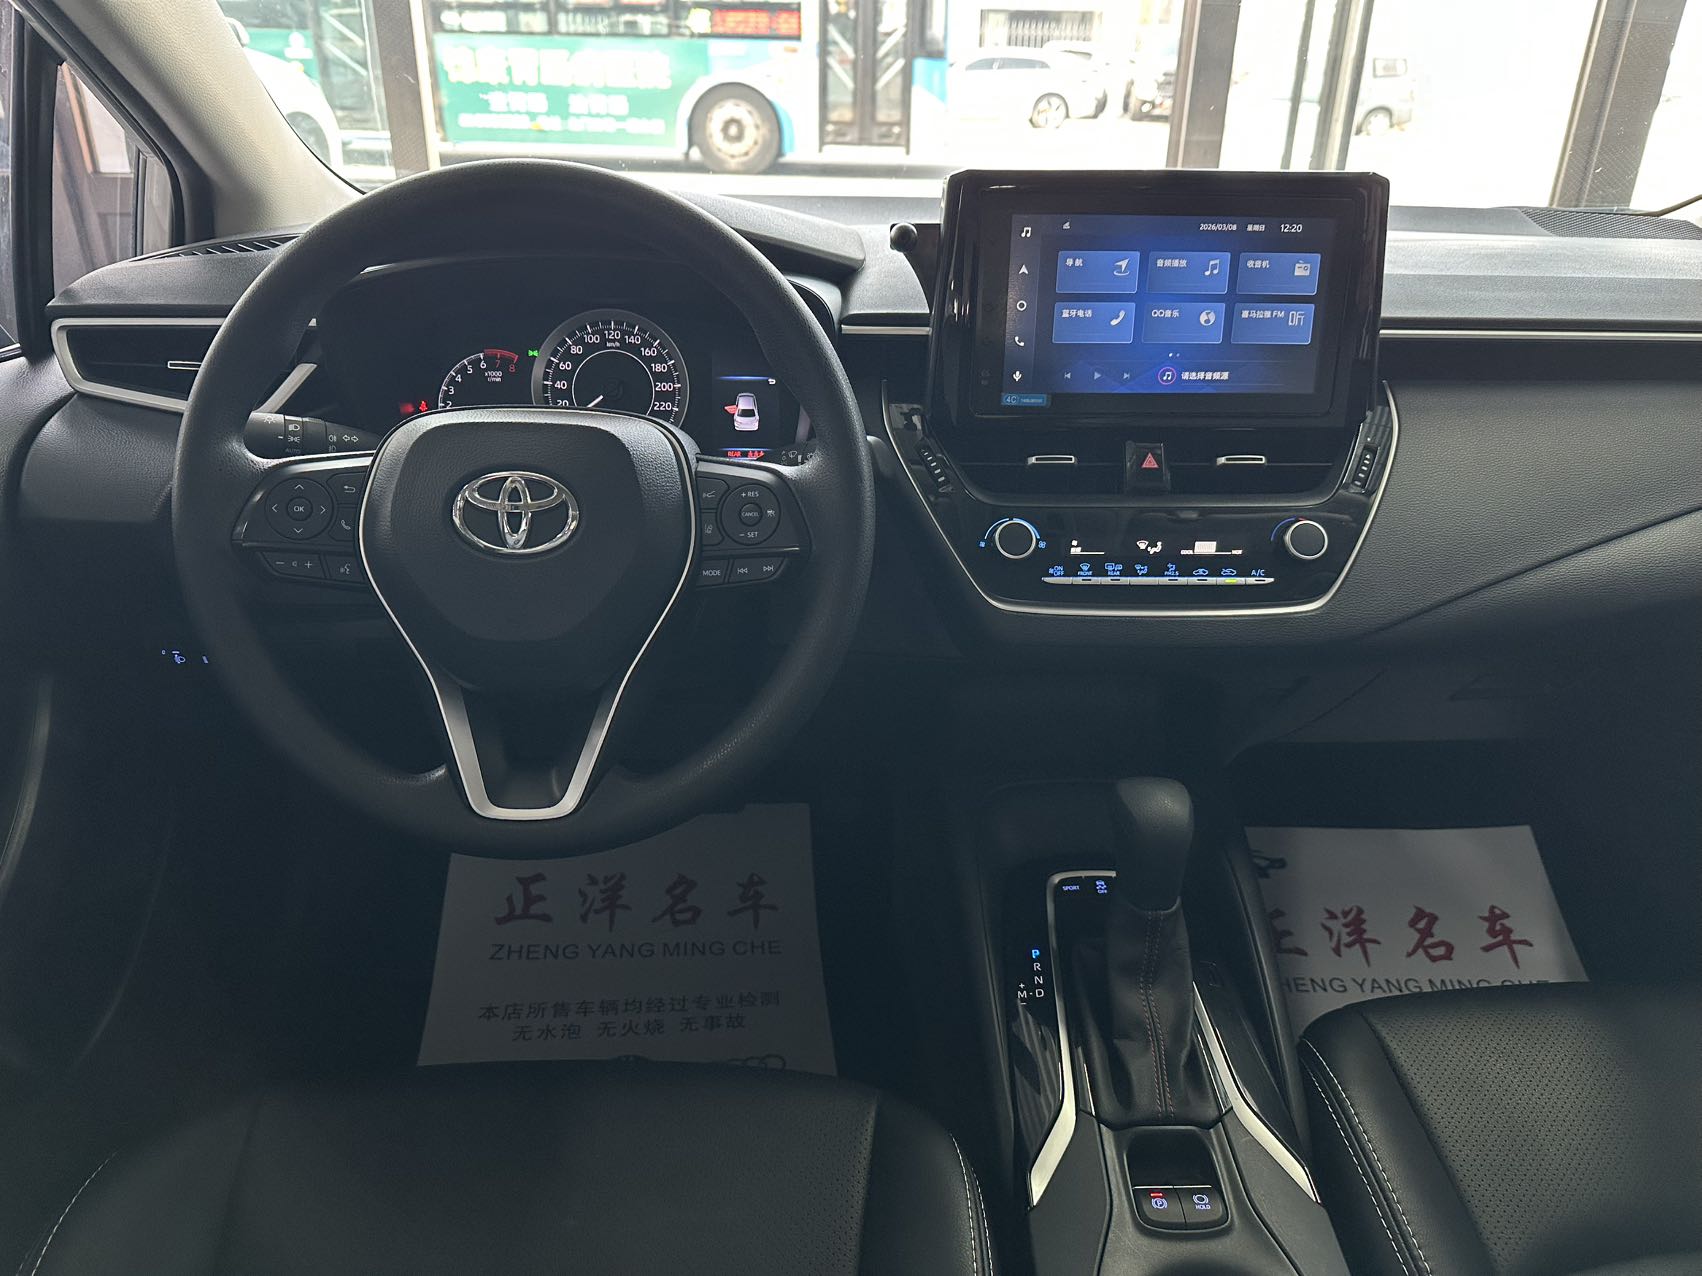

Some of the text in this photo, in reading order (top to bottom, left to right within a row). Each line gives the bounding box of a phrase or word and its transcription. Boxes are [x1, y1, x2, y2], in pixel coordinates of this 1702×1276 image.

[1199, 223, 1303, 233] 2026/03/08 星期日 12:20
[1065, 258, 1083, 267] 导航
[1156, 258, 1187, 267] 音频播放
[1246, 259, 1270, 269] 收音机
[1061, 309, 1093, 318] 蓝牙电话
[1151, 309, 1180, 318] QQ音乐
[1272, 310, 1285, 318] FM
[584, 335, 600, 344] 100
[604, 330, 621, 340] 120
[624, 335, 641, 344] 140
[570, 345, 583, 354] 80
[640, 347, 657, 357] 160
[467, 365, 473, 374] 5
[480, 361, 487, 369] 6
[508, 364, 516, 372] 8
[559, 361, 572, 370] 60
[651, 363, 668, 372] 180
[455, 374, 462, 383] 4
[1181, 371, 1230, 381] 请选择音频源
[554, 380, 567, 390] 40
[655, 382, 674, 391] 200
[448, 386, 455, 395] 3
[446, 401, 452, 409] 2
[653, 402, 672, 411] 220
[494, 872, 781, 932] 正洋名车
[489, 939, 782, 961] ZHENG YANG MING CHE
[1031, 949, 1040, 959] P
[1033, 962, 1042, 971] R
[1034, 975, 1044, 984] N
[1280, 976, 1348, 993] HENG
[1350, 977, 1423, 994] YANG
[1017, 988, 1044, 999] M D
[478, 990, 781, 1022] 本店所售车辆均经过专业检测
[511, 1013, 747, 1042] 无水泡 无火烧 无事故
